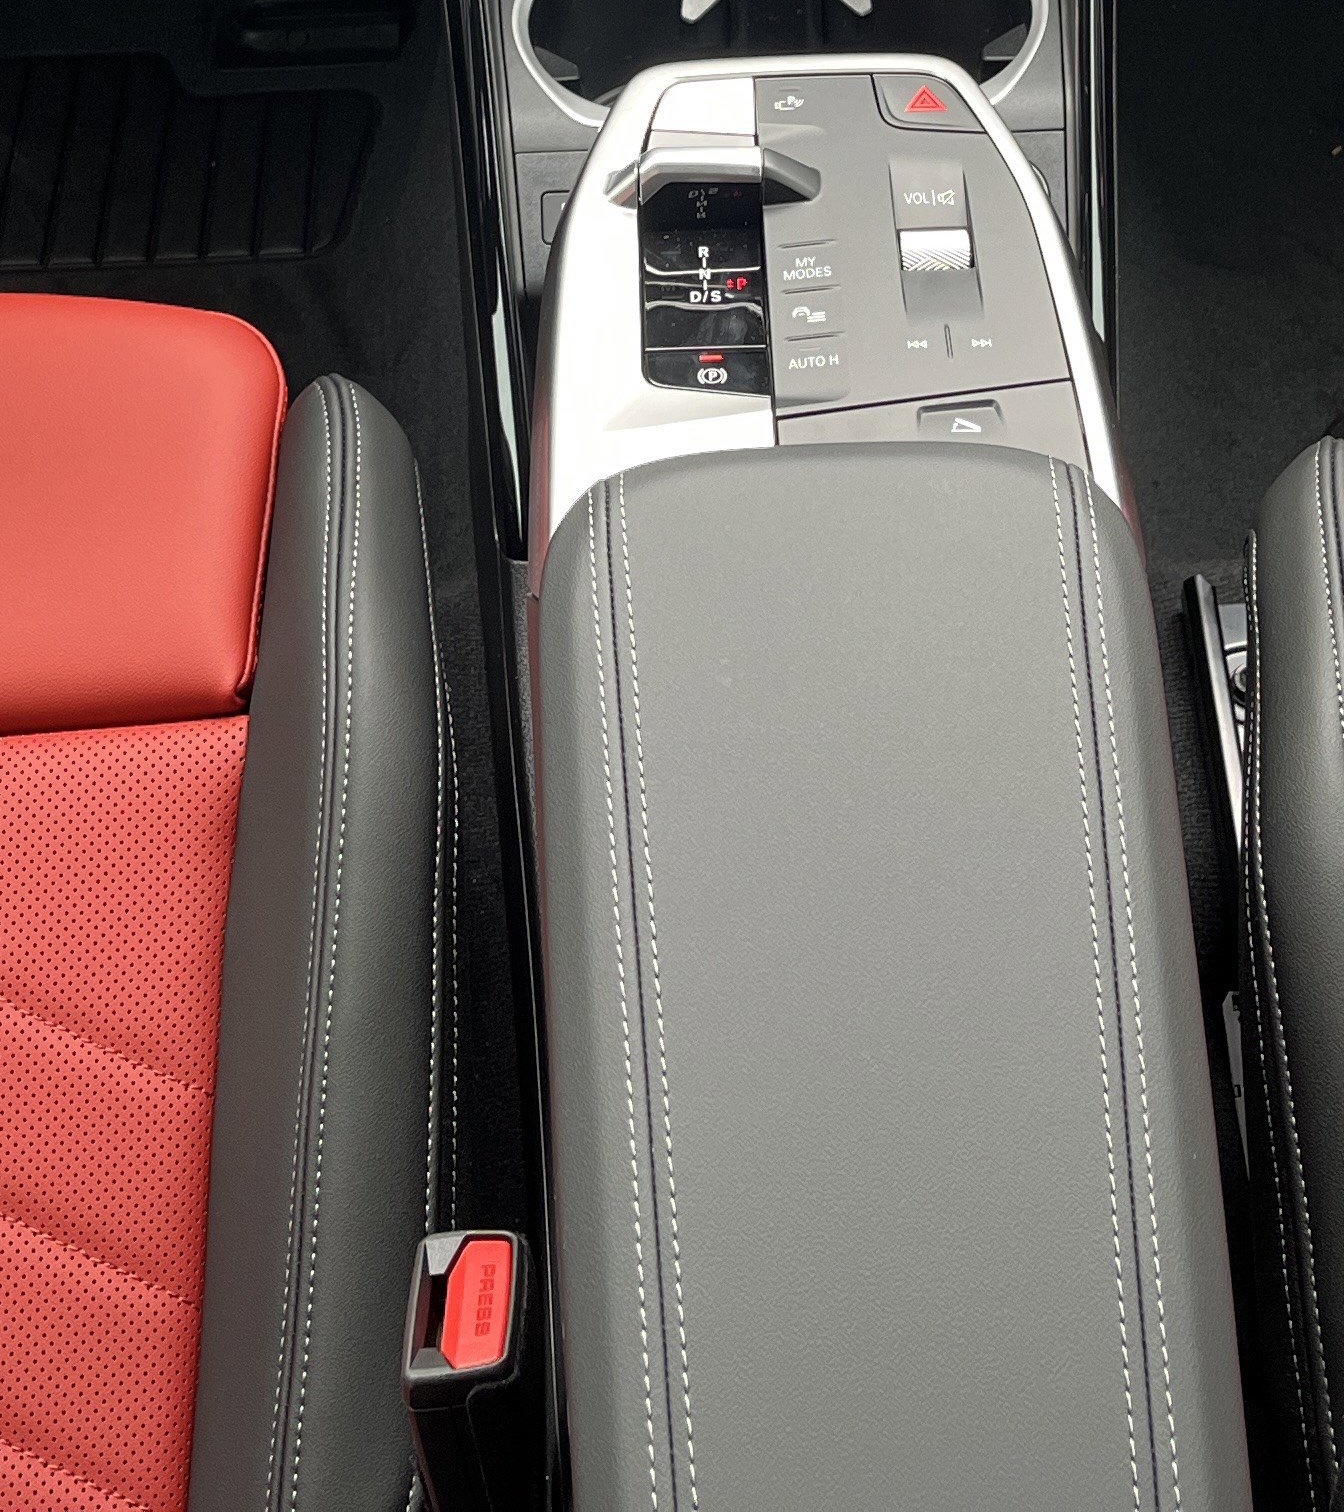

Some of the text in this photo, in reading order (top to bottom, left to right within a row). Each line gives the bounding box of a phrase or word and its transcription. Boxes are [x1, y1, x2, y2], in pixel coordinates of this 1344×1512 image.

[904, 191, 929, 205] VOL
[698, 246, 709, 258] R
[795, 256, 816, 267] MY
[699, 268, 711, 280] N
[783, 266, 832, 281] MODES
[736, 276, 747, 291] P
[690, 290, 722, 303] D/S
[788, 354, 839, 370] AUTO H
